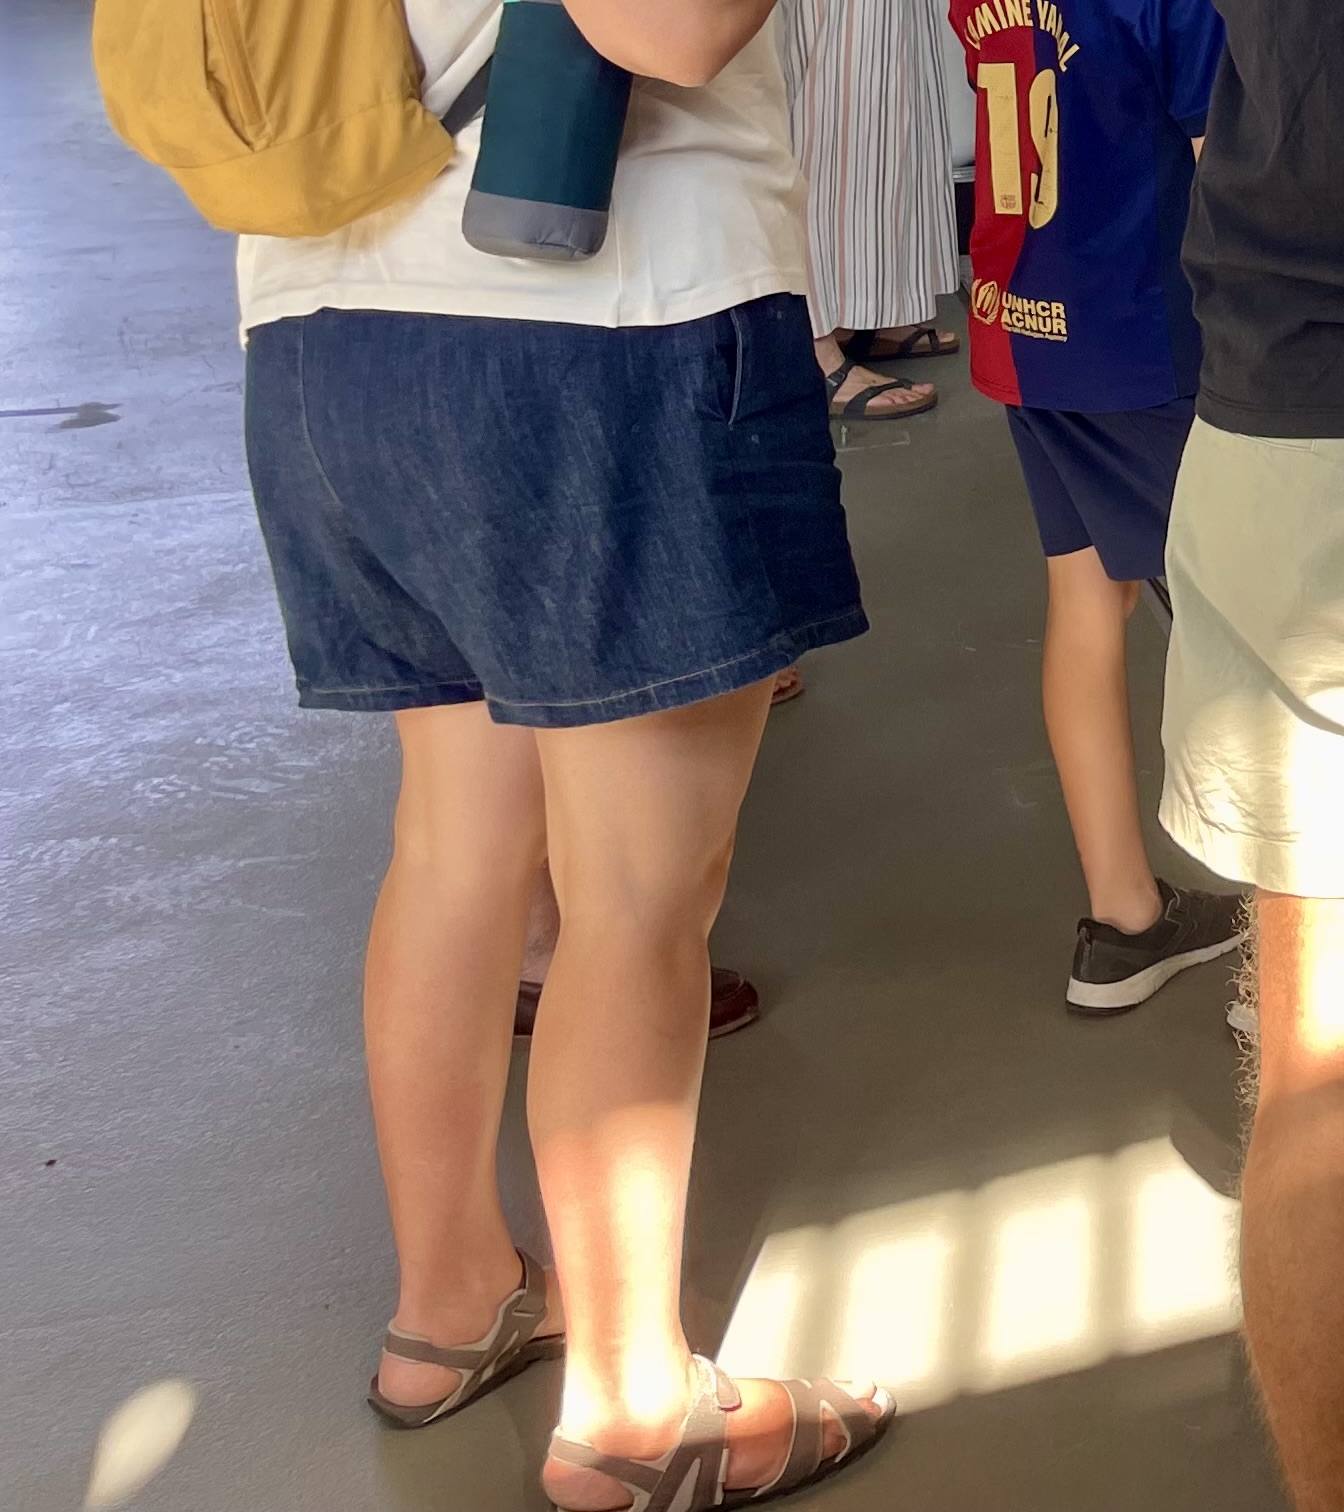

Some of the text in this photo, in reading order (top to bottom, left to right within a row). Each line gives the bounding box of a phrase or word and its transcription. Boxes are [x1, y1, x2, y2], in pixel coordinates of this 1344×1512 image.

[977, 62, 1059, 230] 19
[1001, 291, 1066, 318] UNHCR
[1001, 309, 1068, 335] ACNUR
